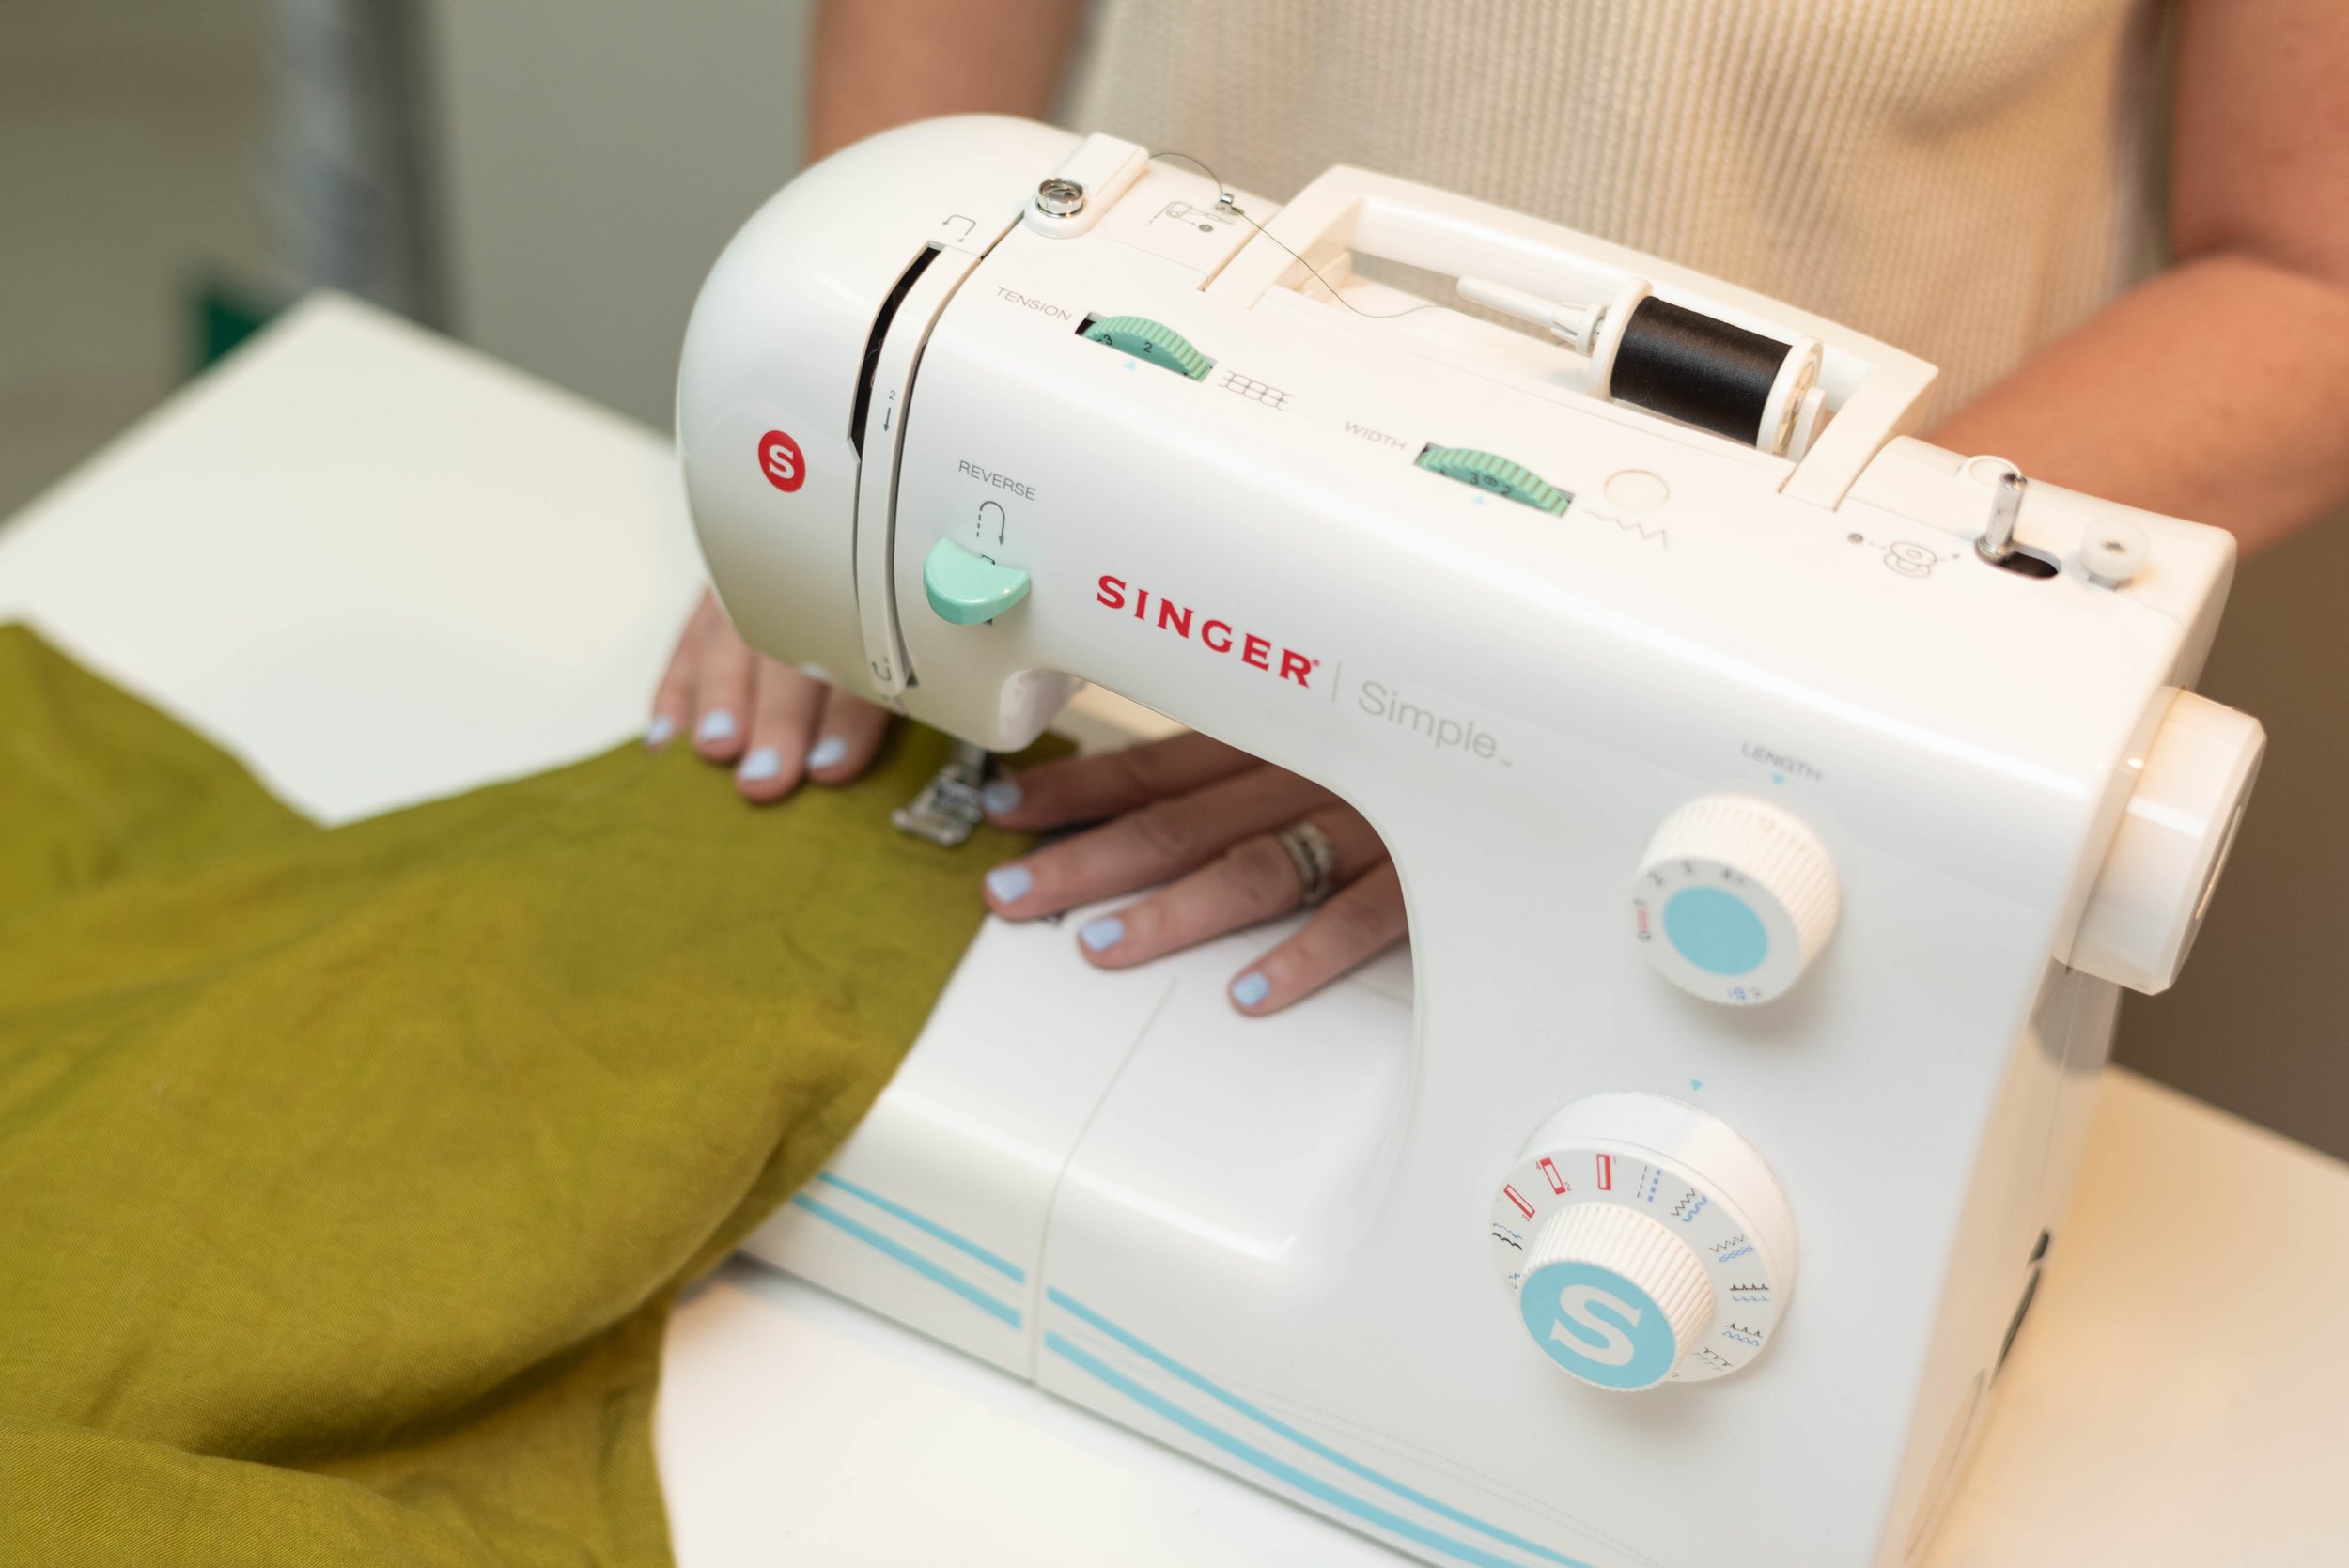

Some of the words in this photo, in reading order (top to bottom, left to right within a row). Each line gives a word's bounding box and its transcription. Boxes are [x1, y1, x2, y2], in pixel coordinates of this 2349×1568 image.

[996, 287, 1072, 321] TENSION
[1103, 334, 1113, 346] 3
[1143, 341, 1153, 353] 2
[888, 390, 896, 400] 2
[1345, 421, 1408, 451] WIDTH
[769, 444, 795, 479] S
[958, 460, 1036, 501] REVERSE
[1741, 741, 1822, 784] LENGTH
[1564, 1181, 1573, 1192] 2
[1549, 1283, 1642, 1366] S
